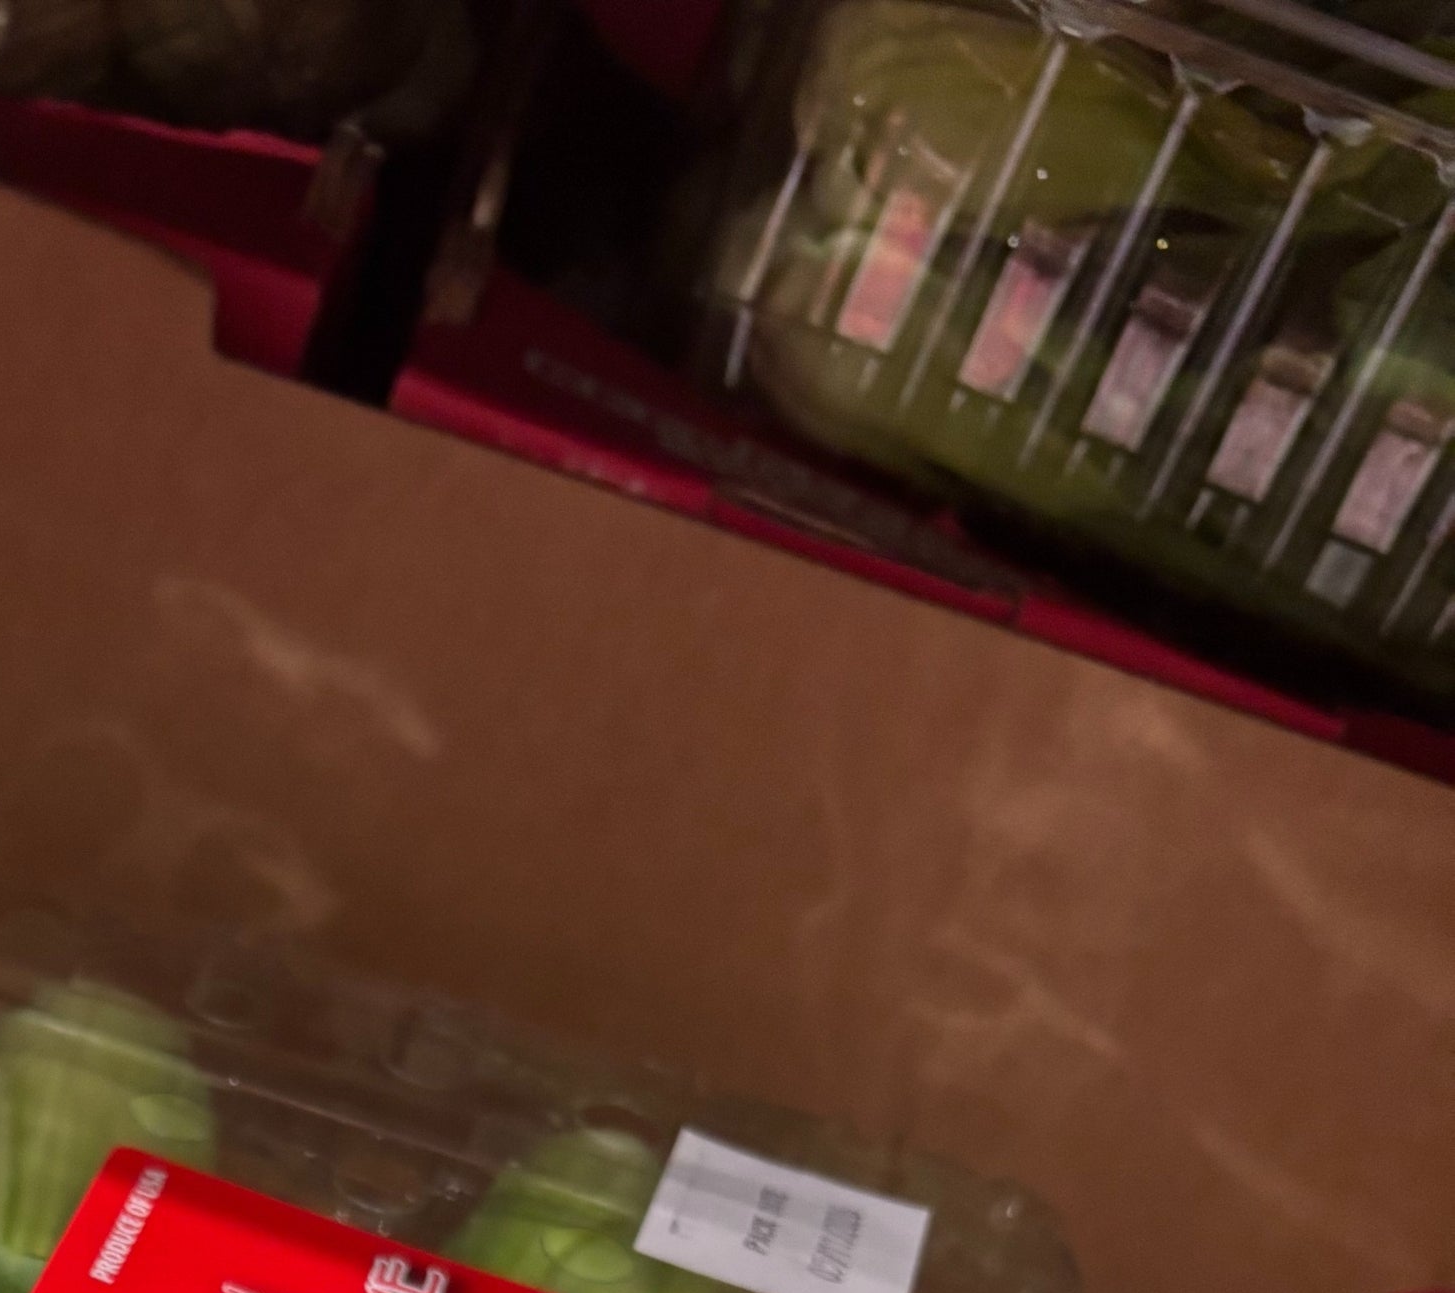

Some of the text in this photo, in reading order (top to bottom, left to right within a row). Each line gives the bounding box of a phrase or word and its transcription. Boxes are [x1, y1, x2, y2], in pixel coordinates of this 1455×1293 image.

[88, 1168, 169, 1285] PRODUCE OF USA
